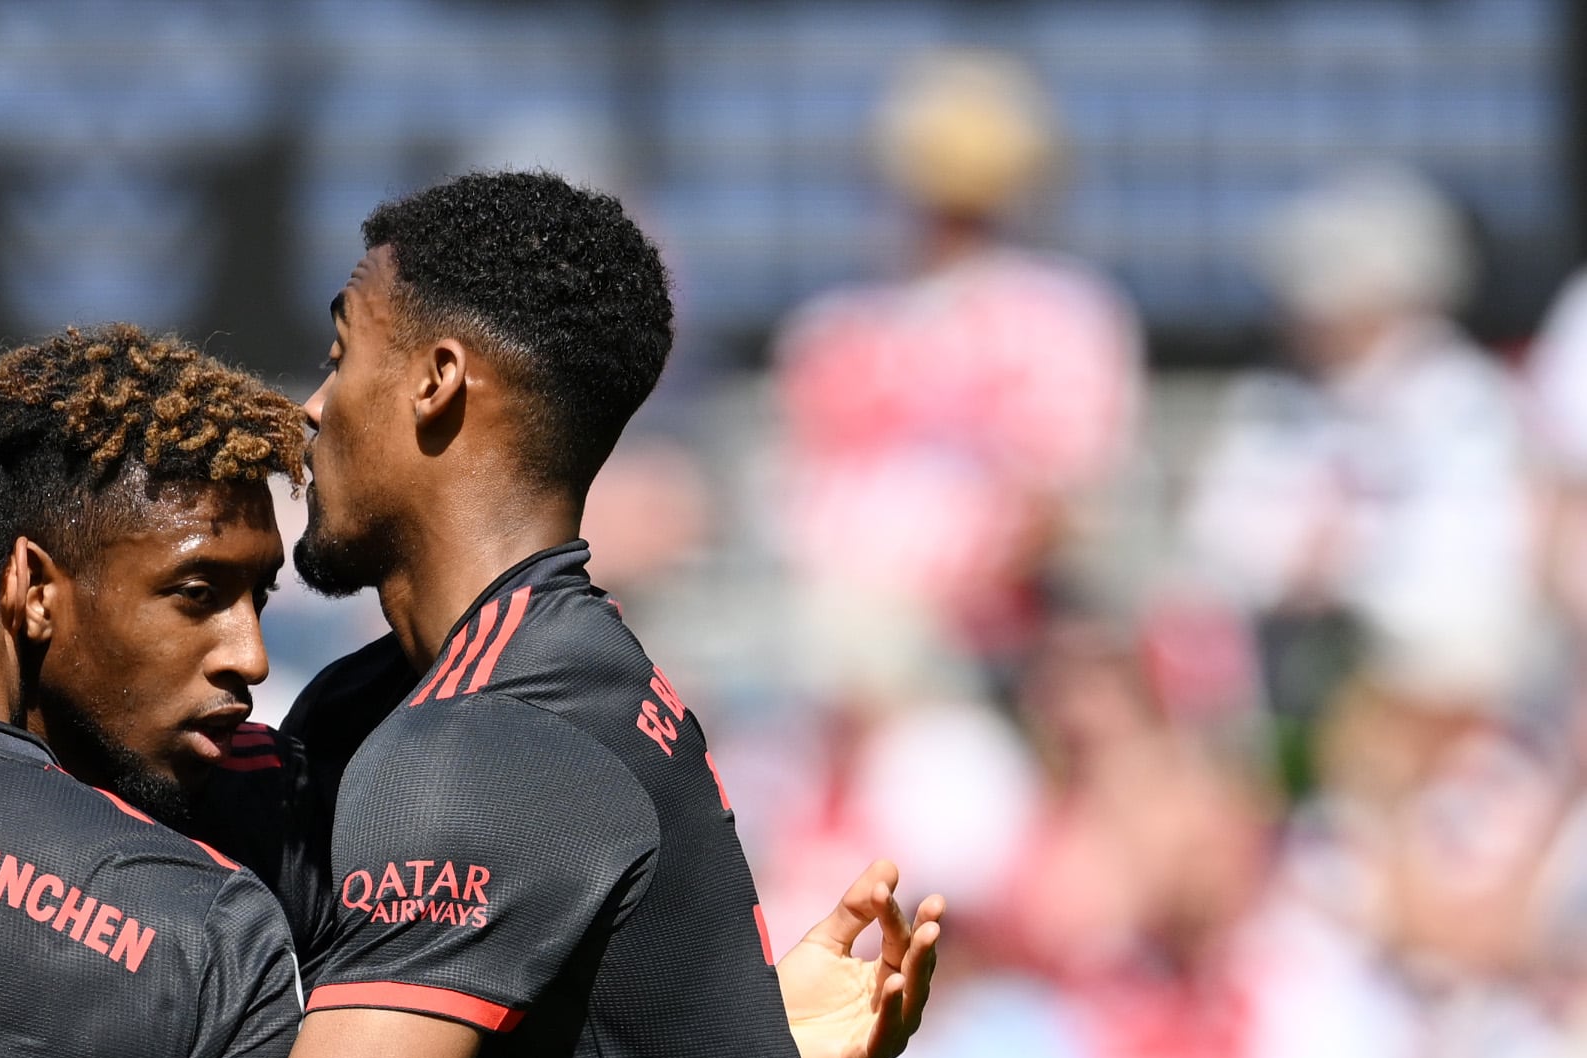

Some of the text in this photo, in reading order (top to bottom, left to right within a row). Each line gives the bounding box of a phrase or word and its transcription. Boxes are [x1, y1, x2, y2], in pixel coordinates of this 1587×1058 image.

[637, 700, 678, 757] FC
[342, 860, 492, 912] QATAR
[370, 899, 488, 929] AIRWAYS
